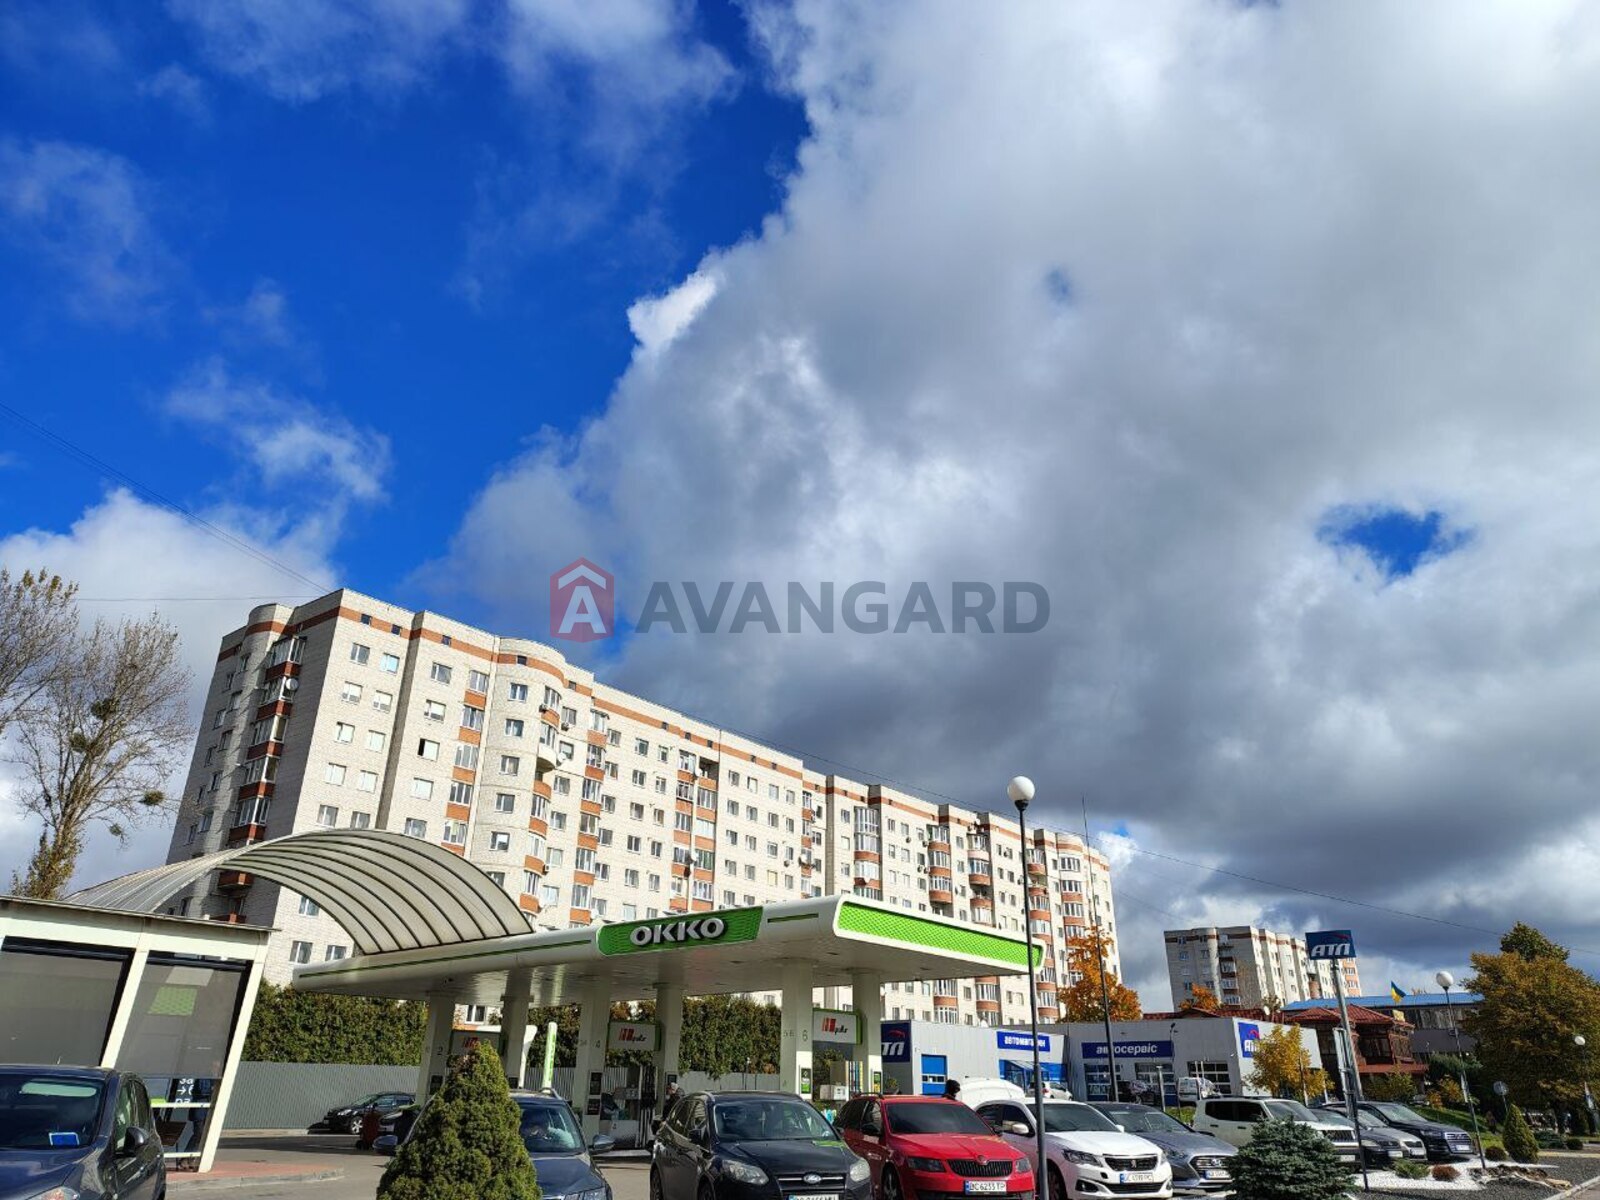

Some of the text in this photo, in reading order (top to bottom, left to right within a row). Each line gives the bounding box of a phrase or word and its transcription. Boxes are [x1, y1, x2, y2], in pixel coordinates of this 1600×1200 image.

[629, 917, 725, 946] OKKO
[881, 1041, 905, 1056] ТЛ
[1096, 1043, 1158, 1056] авосервіс
